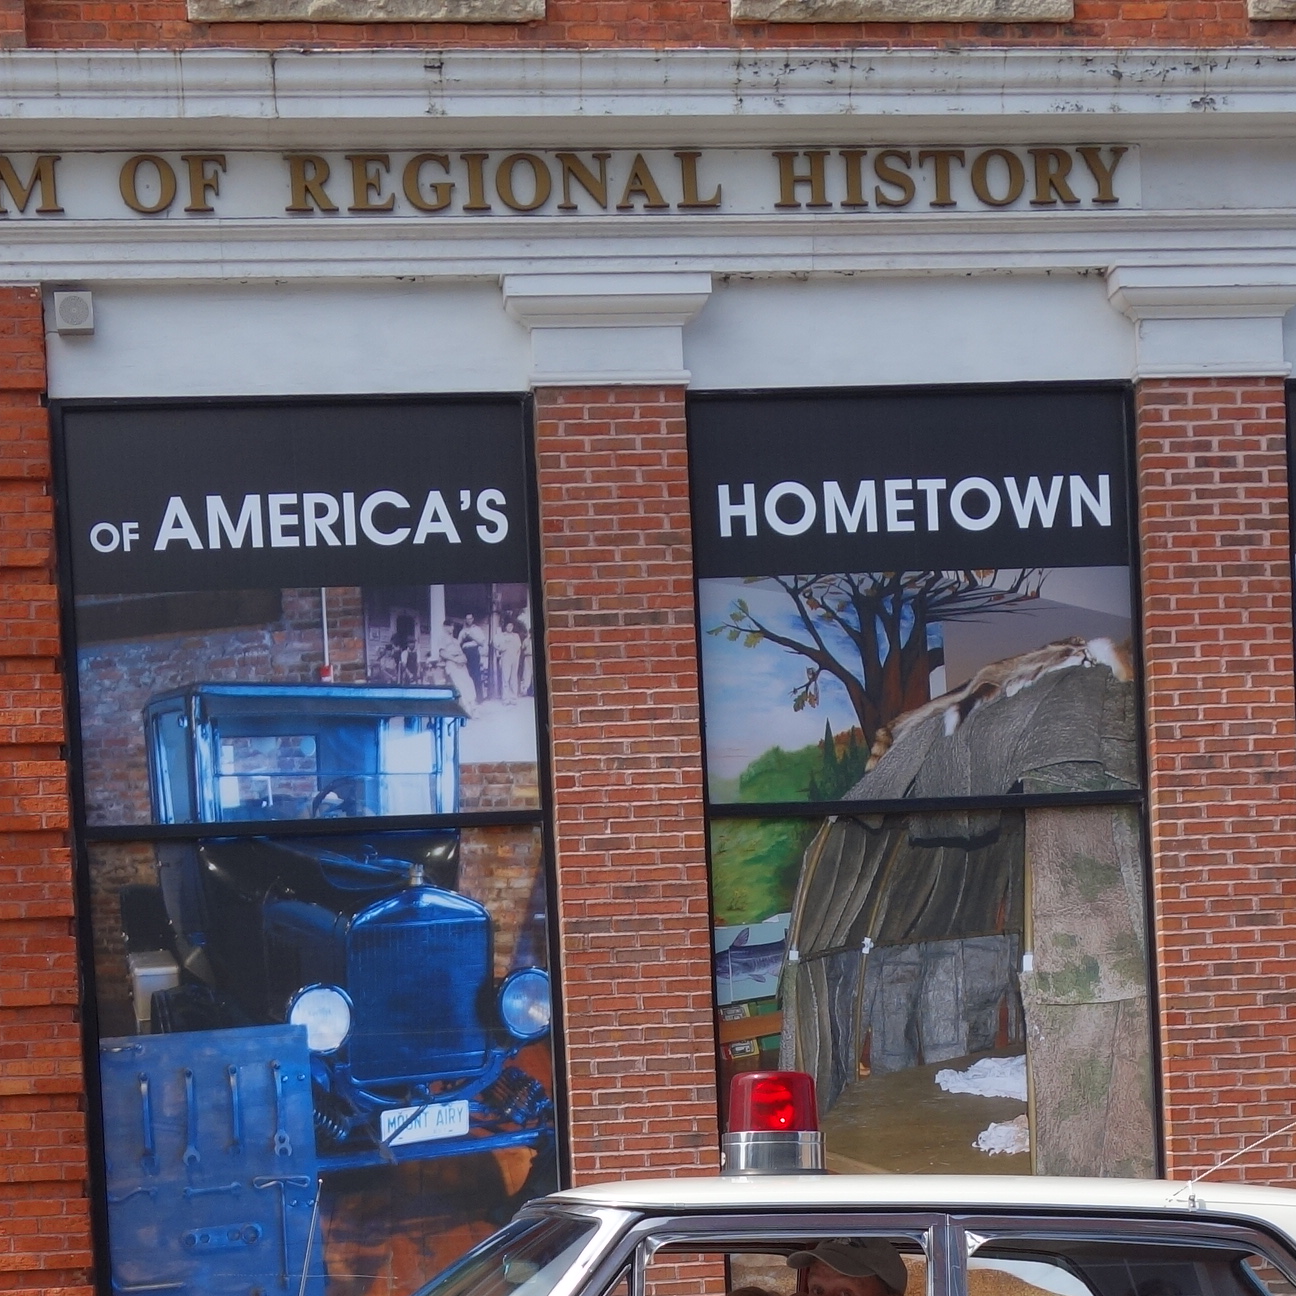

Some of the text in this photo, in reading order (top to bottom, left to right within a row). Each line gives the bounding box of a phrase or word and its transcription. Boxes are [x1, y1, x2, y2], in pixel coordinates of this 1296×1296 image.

[118, 153, 228, 214] OF
[284, 150, 722, 214] REGIONAL
[771, 146, 1129, 208] HISTORY
[90, 487, 509, 553] OF AMERICA'S
[717, 473, 1112, 538] HOMETOWN
[436, 1107, 464, 1126] AIRY
